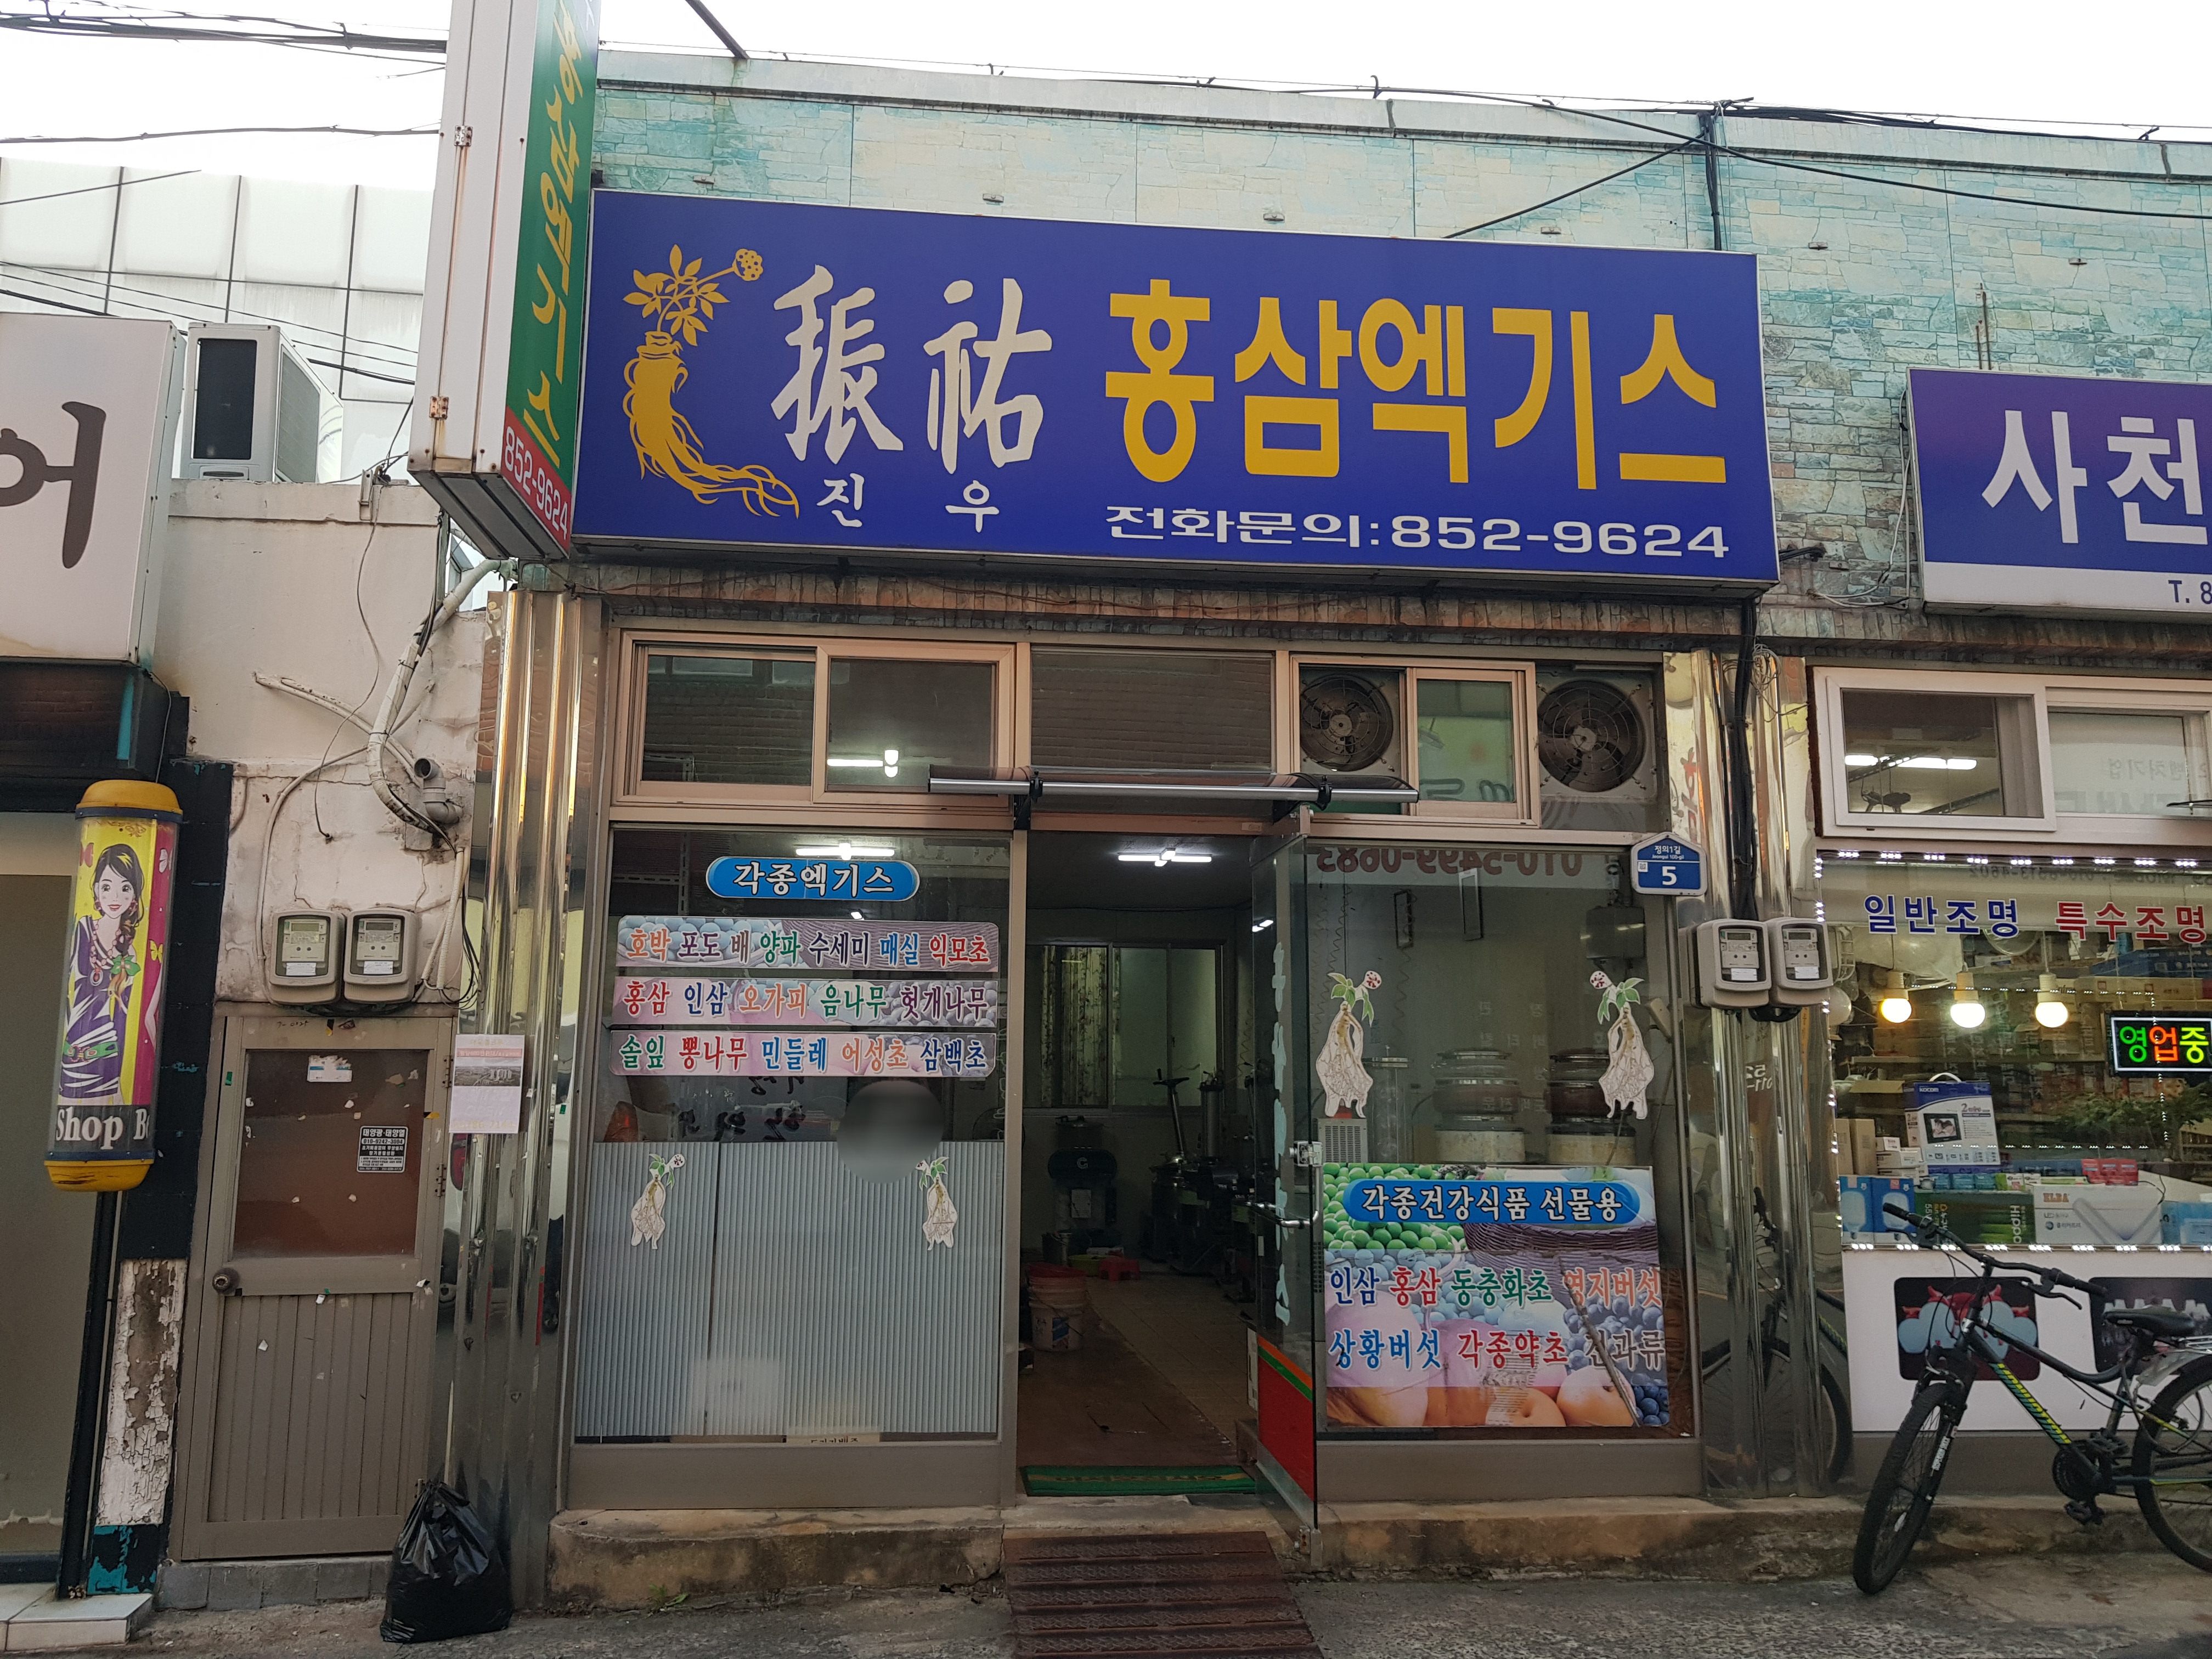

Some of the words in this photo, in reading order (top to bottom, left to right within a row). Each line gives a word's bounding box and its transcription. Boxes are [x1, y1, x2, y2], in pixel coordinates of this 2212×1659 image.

[1105, 278, 1727, 490] 홍삼엑기스
[504, 426, 568, 540] 852-9624
[1982, 410, 2208, 545] 사천
[1655, 845, 1681, 854] 정의1길
[732, 861, 895, 897] 각종엑기스
[1662, 866, 1677, 885] 5
[1865, 894, 2019, 938] 일반조명
[2056, 901, 2207, 944] 특수조명
[627, 928, 671, 962] 호박
[677, 931, 721, 958] 포도
[730, 929, 750, 964] 배
[760, 930, 801, 964] 양파
[808, 931, 870, 968] 수세미
[879, 933, 919, 967] 매실
[930, 933, 989, 968] 익모초
[623, 980, 671, 1016] 홍삼
[684, 981, 729, 1017] 인삼
[740, 983, 806, 1018] 오가피
[820, 984, 887, 1019] 음나무
[900, 985, 989, 1021] 헛개나무
[619, 1035, 665, 1070] 솔잎
[679, 1036, 748, 1071] 뽕나무
[761, 1036, 827, 1072] 민들레
[842, 1037, 908, 1073] 어성초
[921, 1039, 986, 1075] 삼백초
[2119, 1025, 2209, 1064] 영업중
[56, 1106, 123, 1150] Shop
[1362, 1185, 1531, 1221] 각종건강식품
[1541, 1186, 1622, 1223] 선물용
[2010, 1205, 2023, 1244] Hippo
[1329, 1267, 1380, 1306] 인삼
[1390, 1266, 1442, 1307] 홍삼
[1451, 1267, 1553, 1308] 동충화초
[1563, 1267, 1663, 1307] 영지버섯
[1329, 1328, 1442, 1370] 상황버섯
[1457, 1329, 1570, 1370] 각종약초
